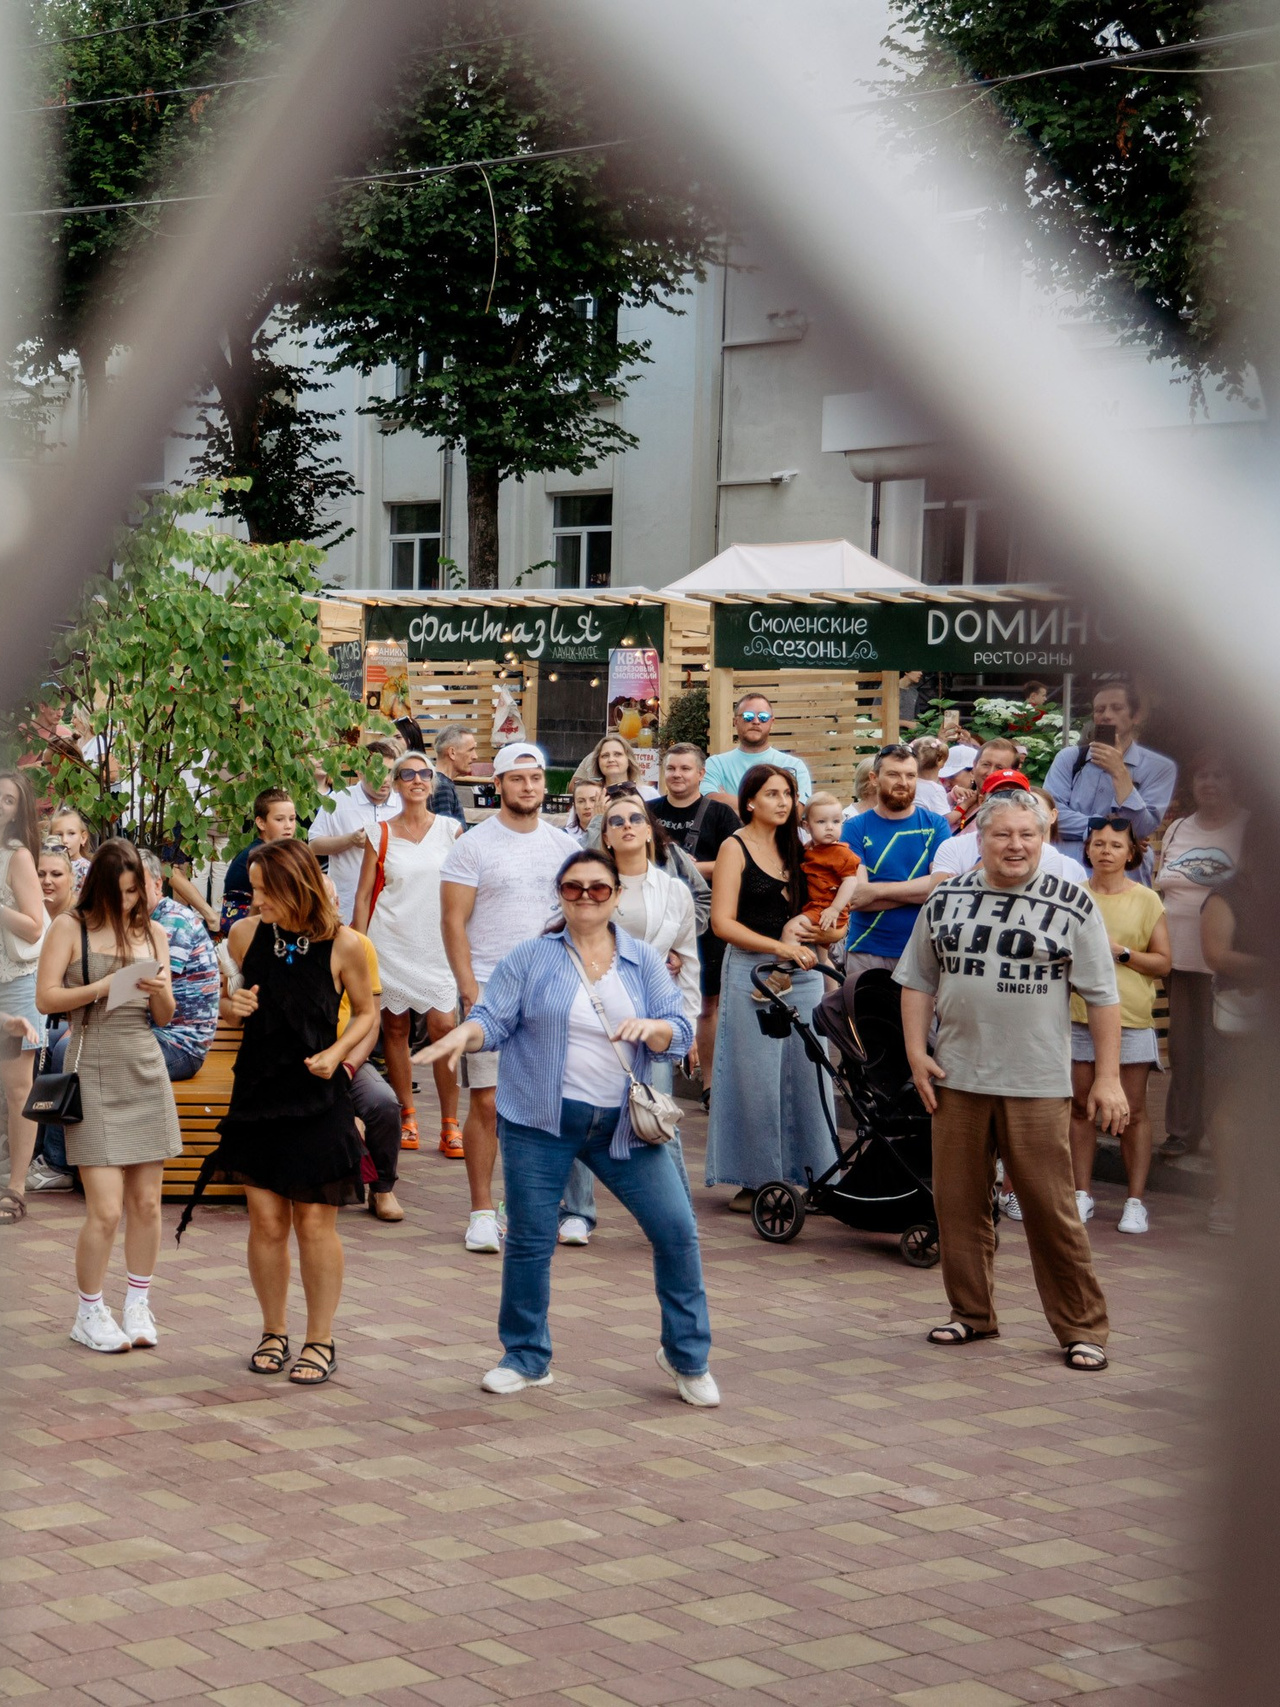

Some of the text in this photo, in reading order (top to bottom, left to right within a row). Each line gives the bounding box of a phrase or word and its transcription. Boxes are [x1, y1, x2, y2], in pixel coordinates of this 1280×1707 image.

[748, 611, 868, 635] Смоленские
[773, 639, 847, 659] сезоны
[617, 651, 653, 665] КВАС
[974, 651, 1073, 666] рестораны
[999, 962, 1065, 981] LIFE
[996, 981, 1048, 995] SINCE/89
